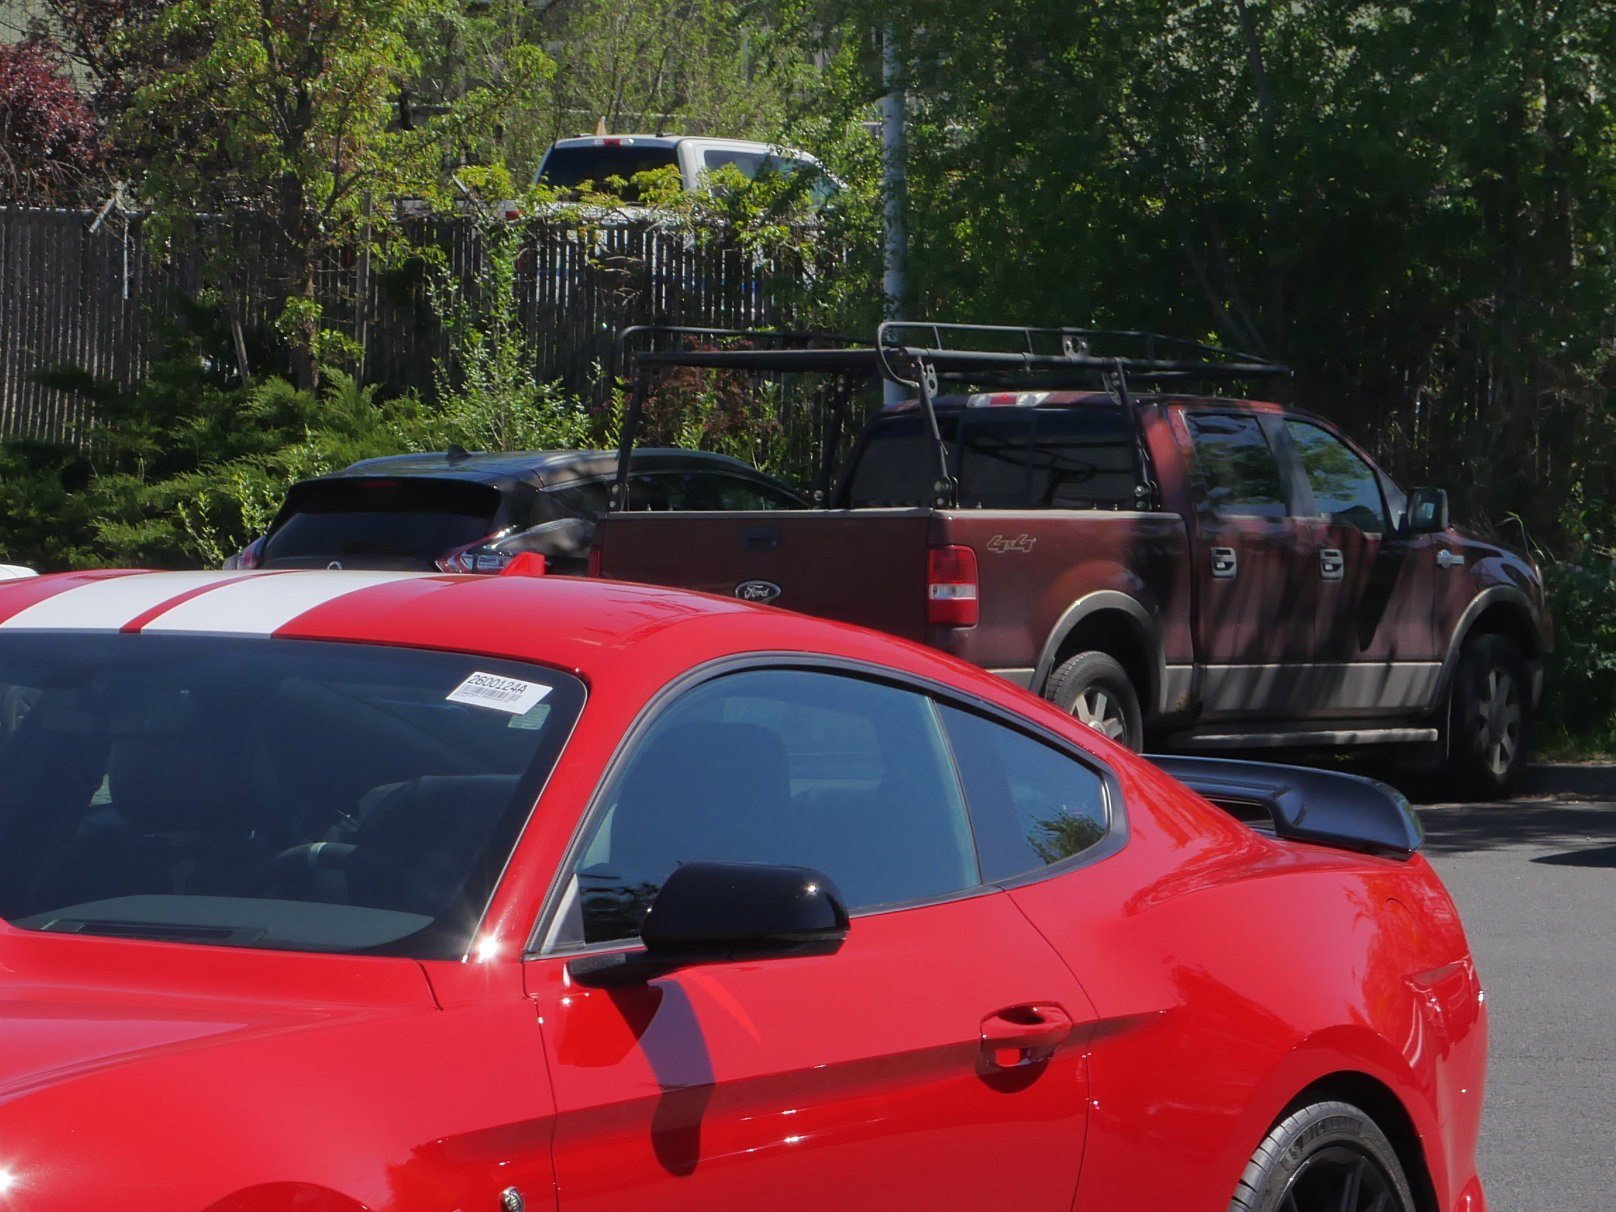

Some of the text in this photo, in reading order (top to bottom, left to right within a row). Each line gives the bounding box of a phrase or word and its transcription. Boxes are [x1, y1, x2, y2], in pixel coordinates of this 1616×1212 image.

[987, 534, 1036, 553] 4x4
[744, 584, 770, 599] Ford
[467, 675, 528, 694] 2600124A
